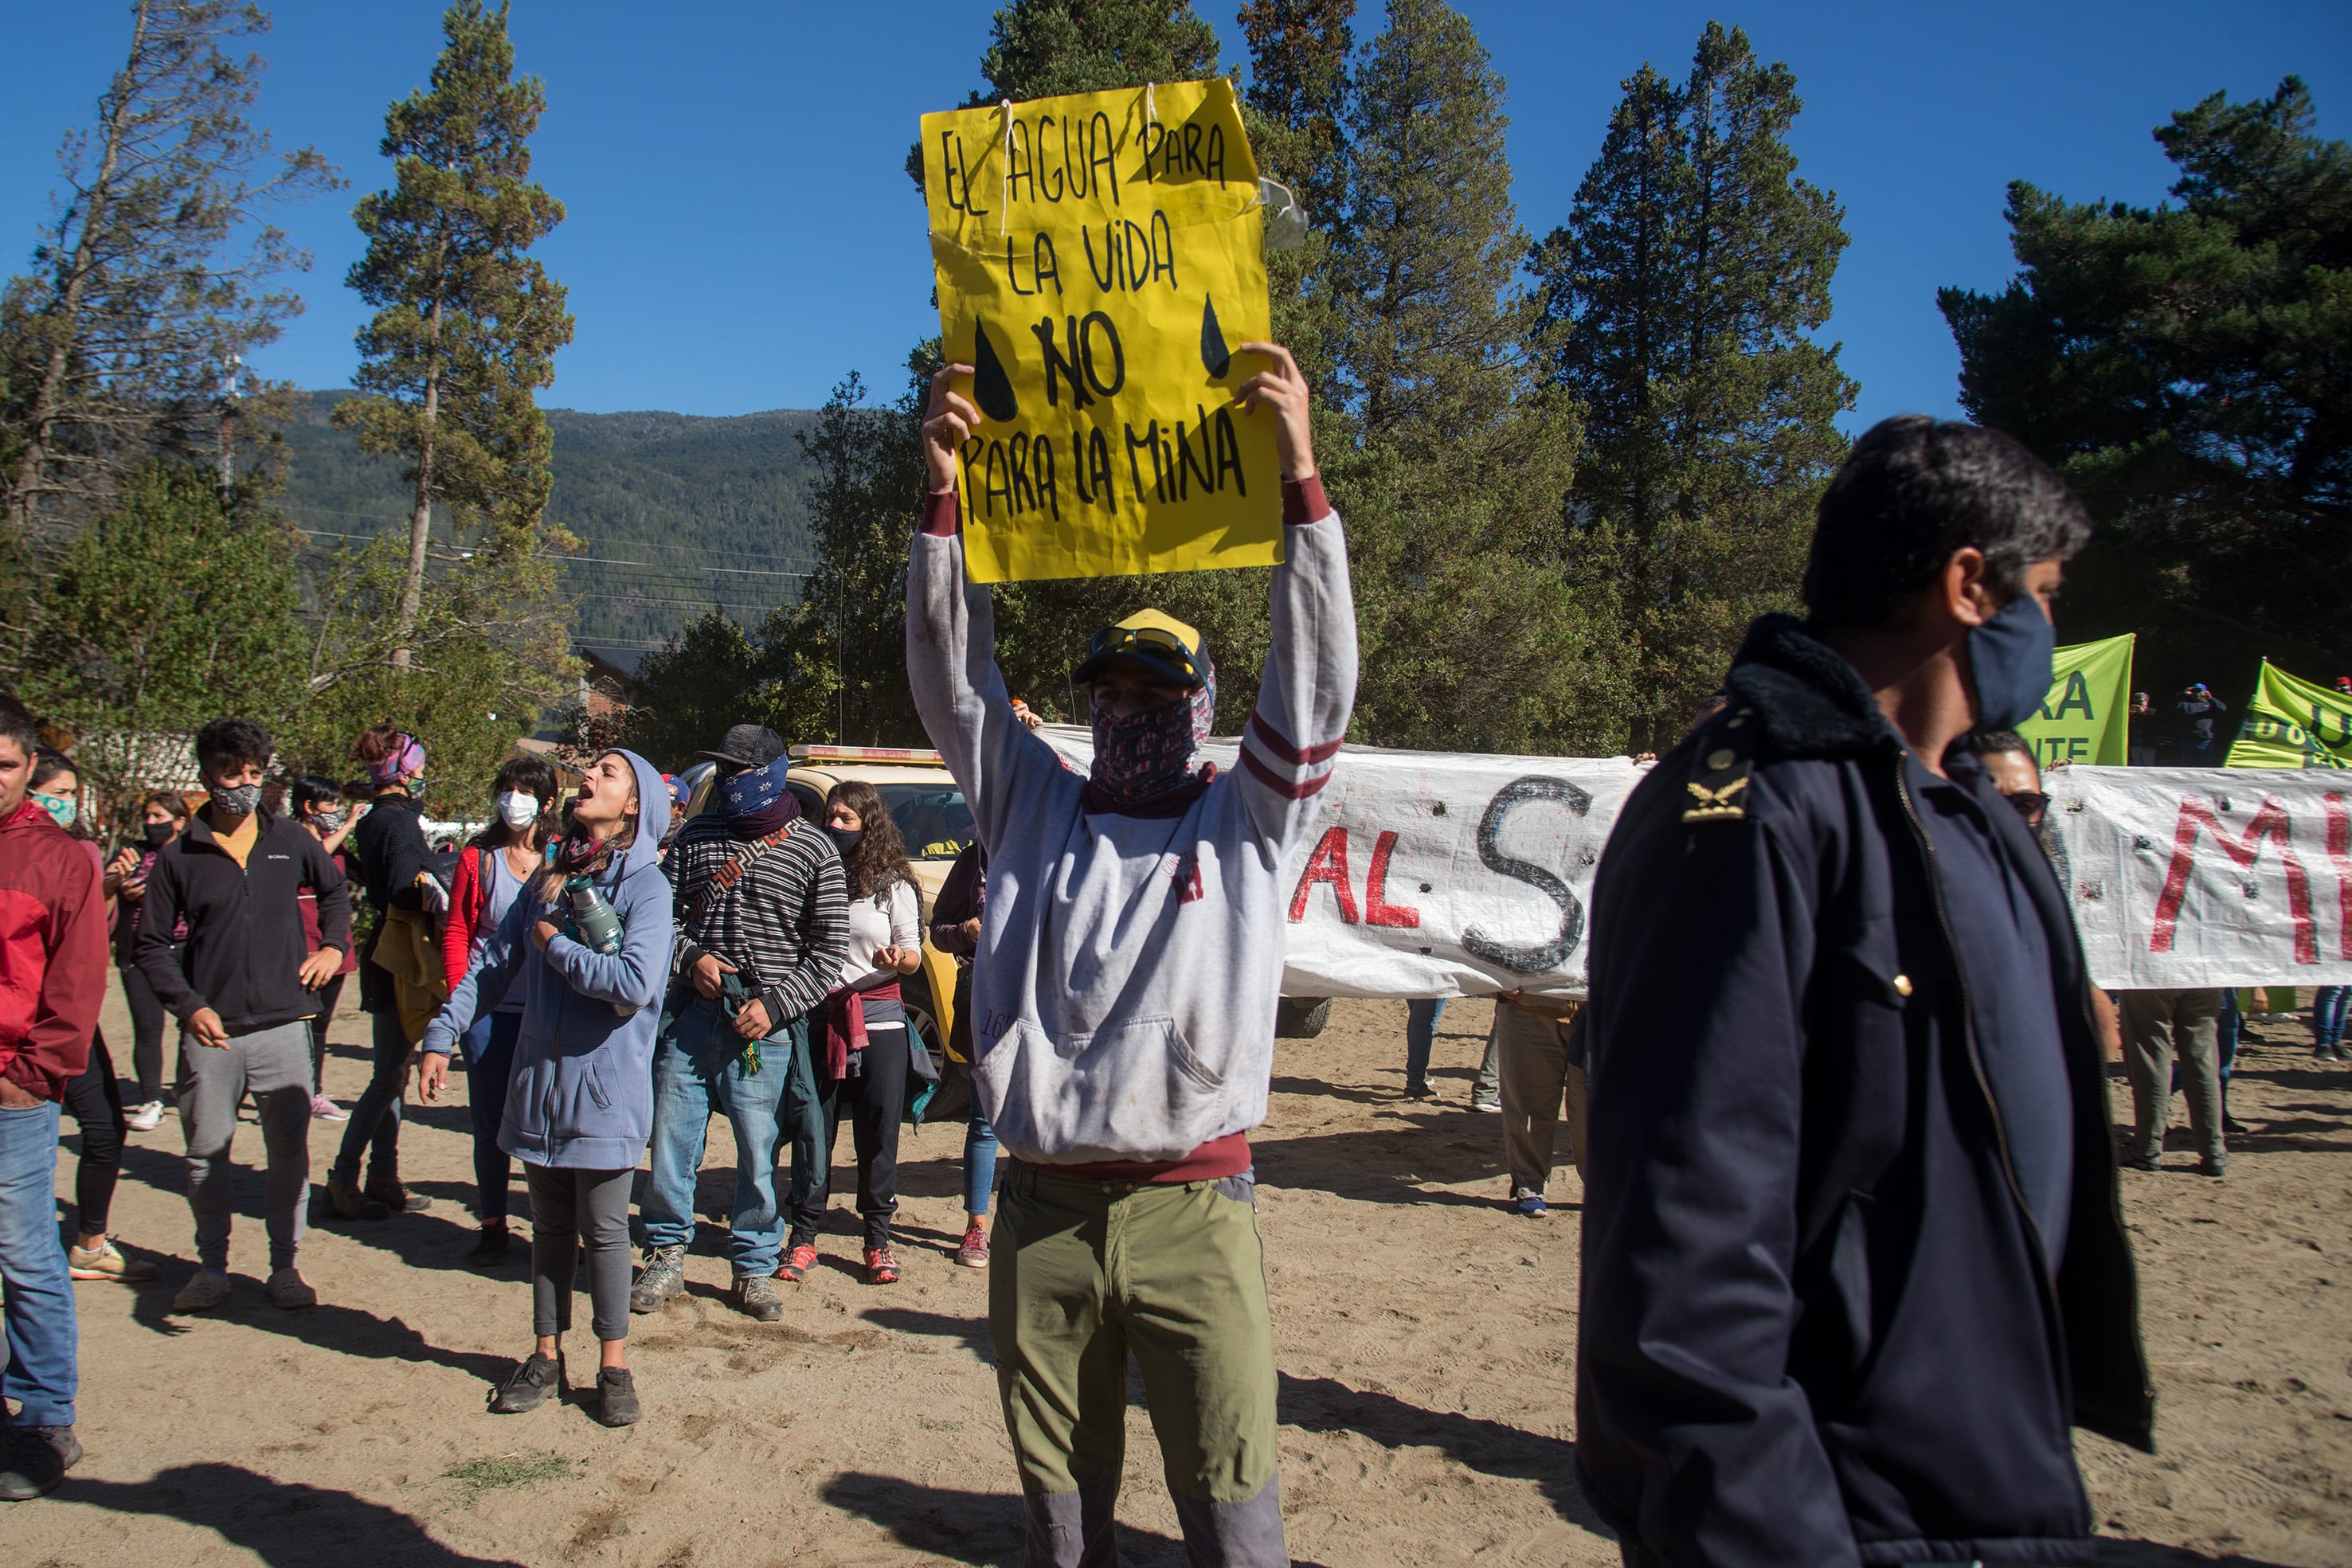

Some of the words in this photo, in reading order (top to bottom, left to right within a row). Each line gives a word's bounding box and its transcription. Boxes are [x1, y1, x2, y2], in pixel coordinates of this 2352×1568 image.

[941, 130, 989, 215] EL
[1006, 111, 1121, 206] AGUA
[1135, 122, 1227, 190] PARA
[1006, 231, 1063, 295] LA
[1031, 311, 1125, 410] NO
[960, 431, 1059, 525] PARA
[1073, 425, 1117, 514] LA
[1287, 825, 1421, 928] AL
